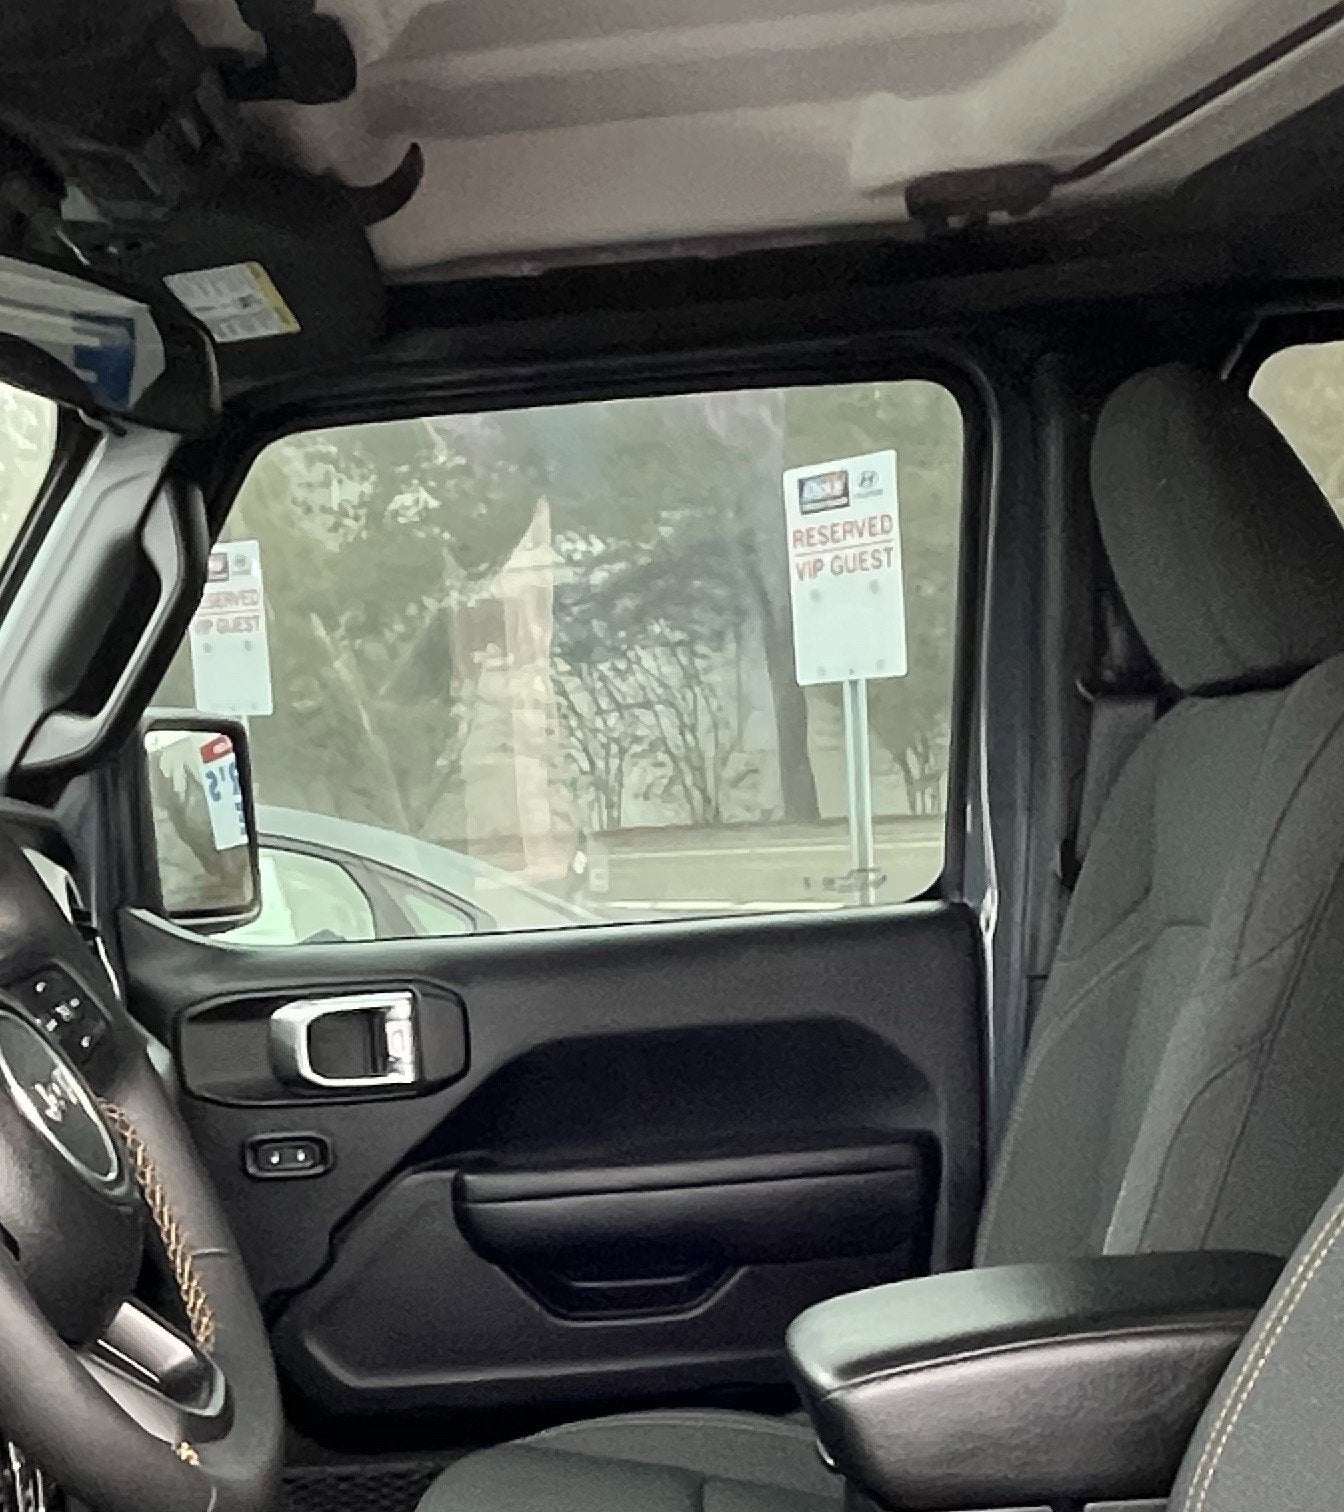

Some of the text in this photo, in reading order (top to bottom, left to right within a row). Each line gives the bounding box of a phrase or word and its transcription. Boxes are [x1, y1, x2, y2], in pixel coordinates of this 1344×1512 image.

[793, 514, 893, 548] RESERVED
[796, 547, 894, 580] VIP GUEST
